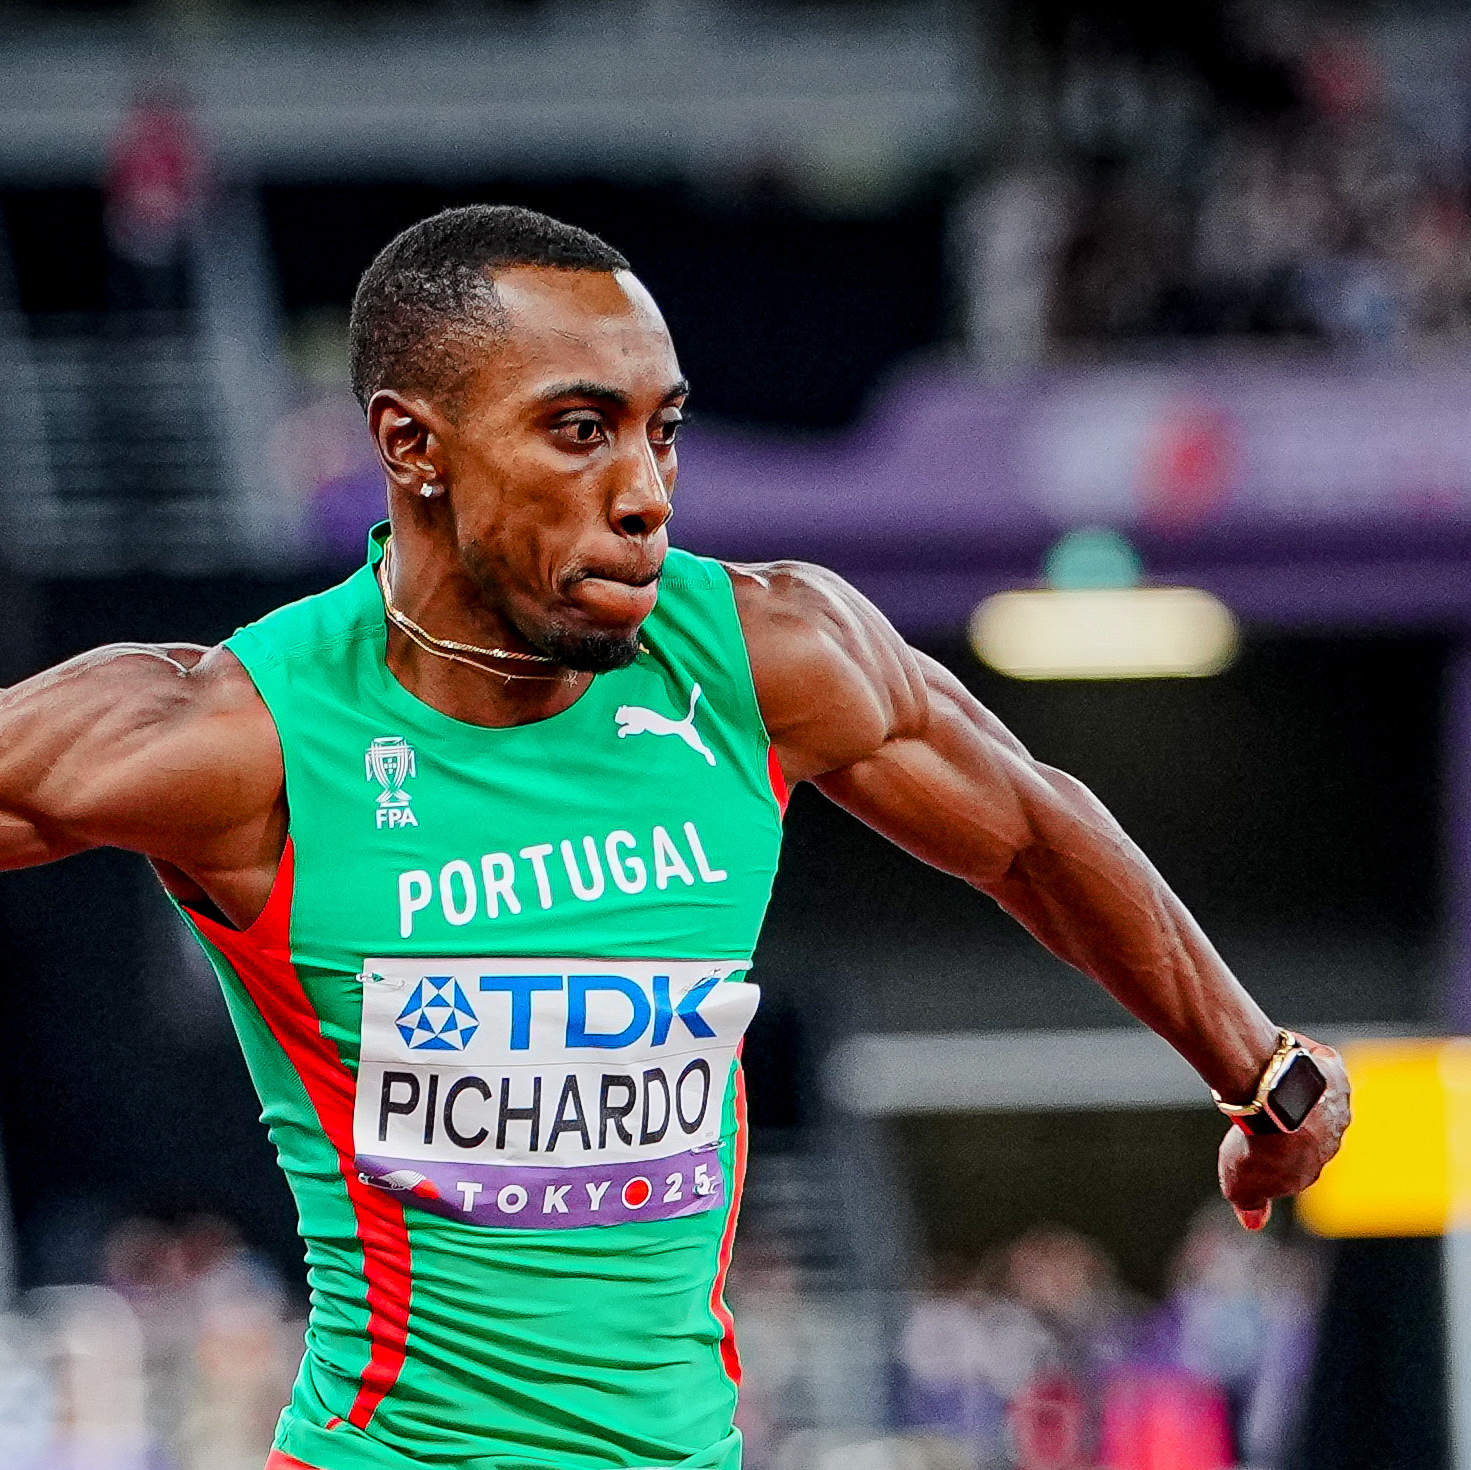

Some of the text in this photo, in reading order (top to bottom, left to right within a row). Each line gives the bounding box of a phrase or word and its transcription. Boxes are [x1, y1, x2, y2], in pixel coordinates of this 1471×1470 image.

[375, 806, 419, 830] FPA
[397, 821, 728, 939] PORTUGAL
[478, 974, 723, 1052] TDK
[377, 1057, 711, 1153] PICHARDO
